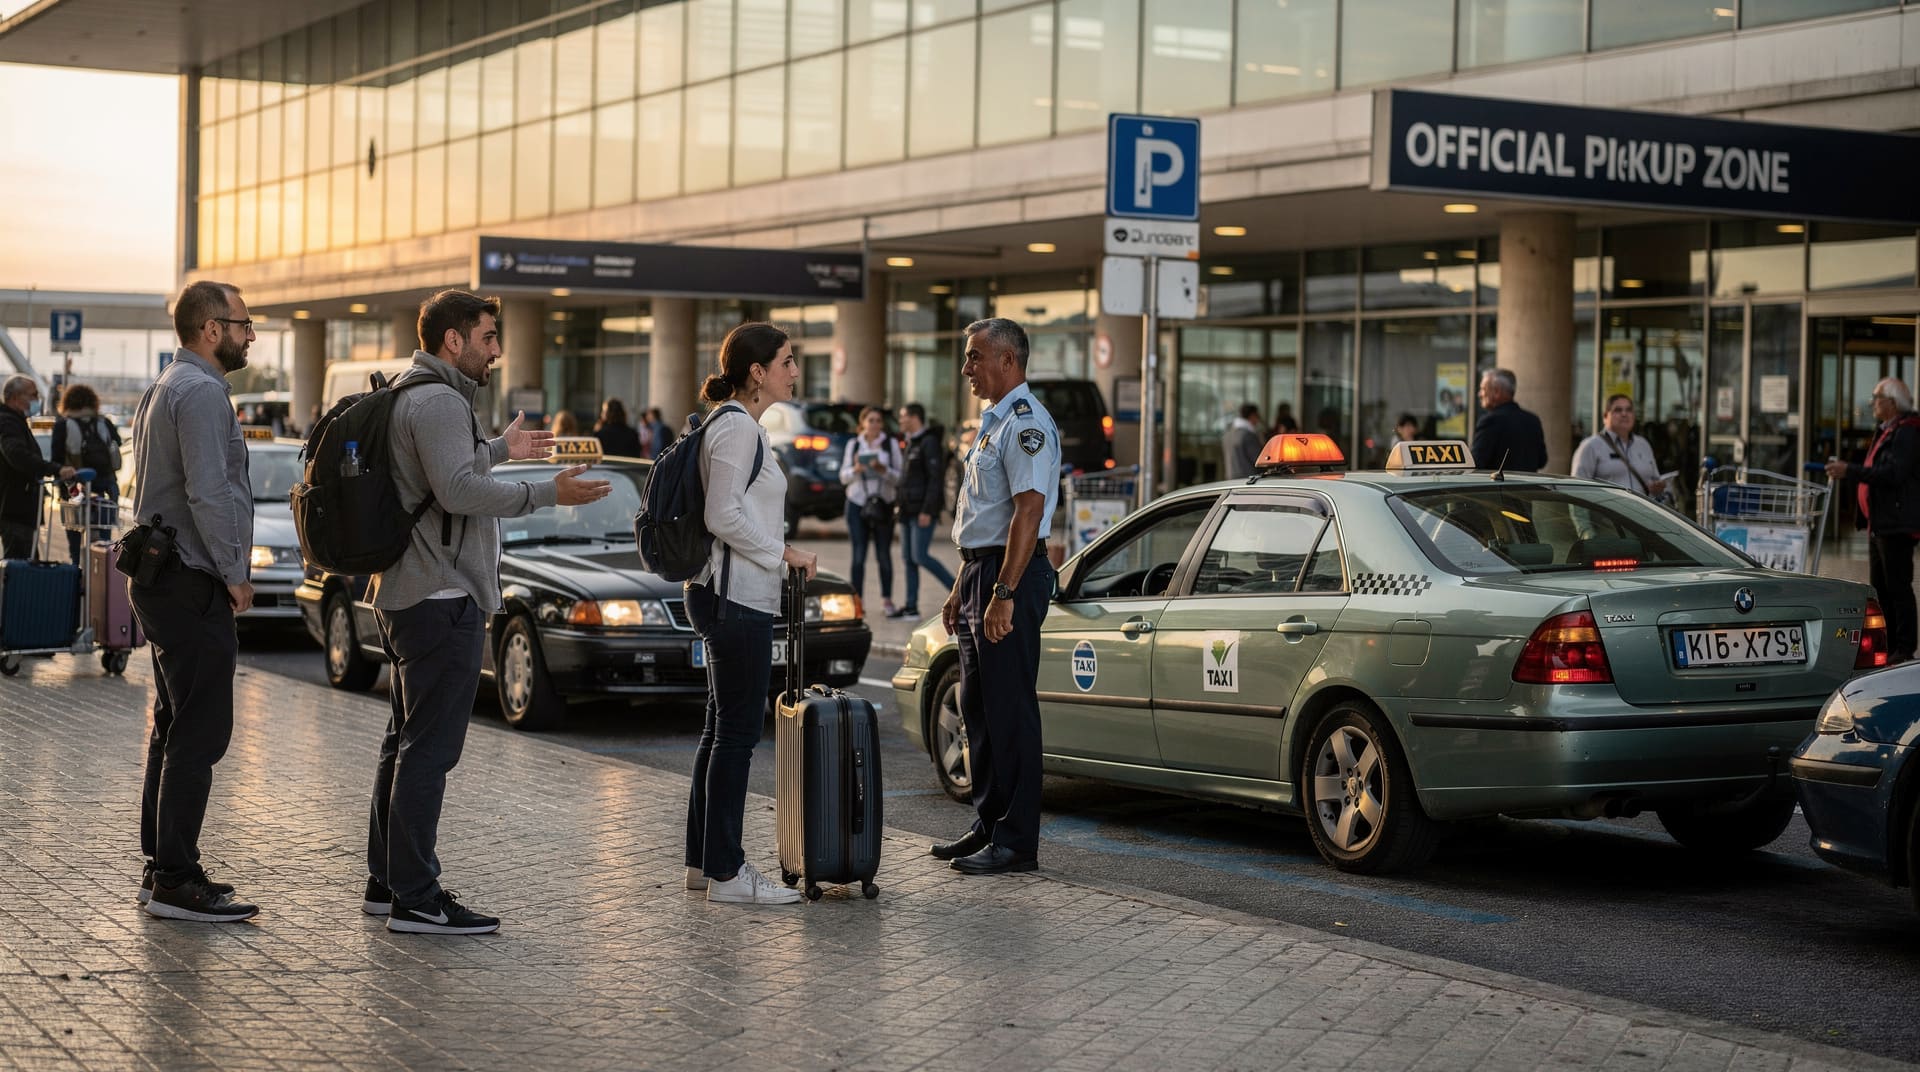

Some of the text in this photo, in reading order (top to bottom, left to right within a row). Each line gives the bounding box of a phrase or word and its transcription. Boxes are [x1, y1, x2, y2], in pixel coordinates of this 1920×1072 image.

[1405, 121, 1576, 178] OFFICIAL
[1702, 145, 1790, 193] ZONE
[1134, 138, 1184, 208] P
[58, 314, 78, 339] P
[561, 440, 597, 454] TAXI
[1410, 445, 1462, 463] TAXI
[1074, 659, 1096, 673] TAXI
[1206, 669, 1233, 687] TAXI
